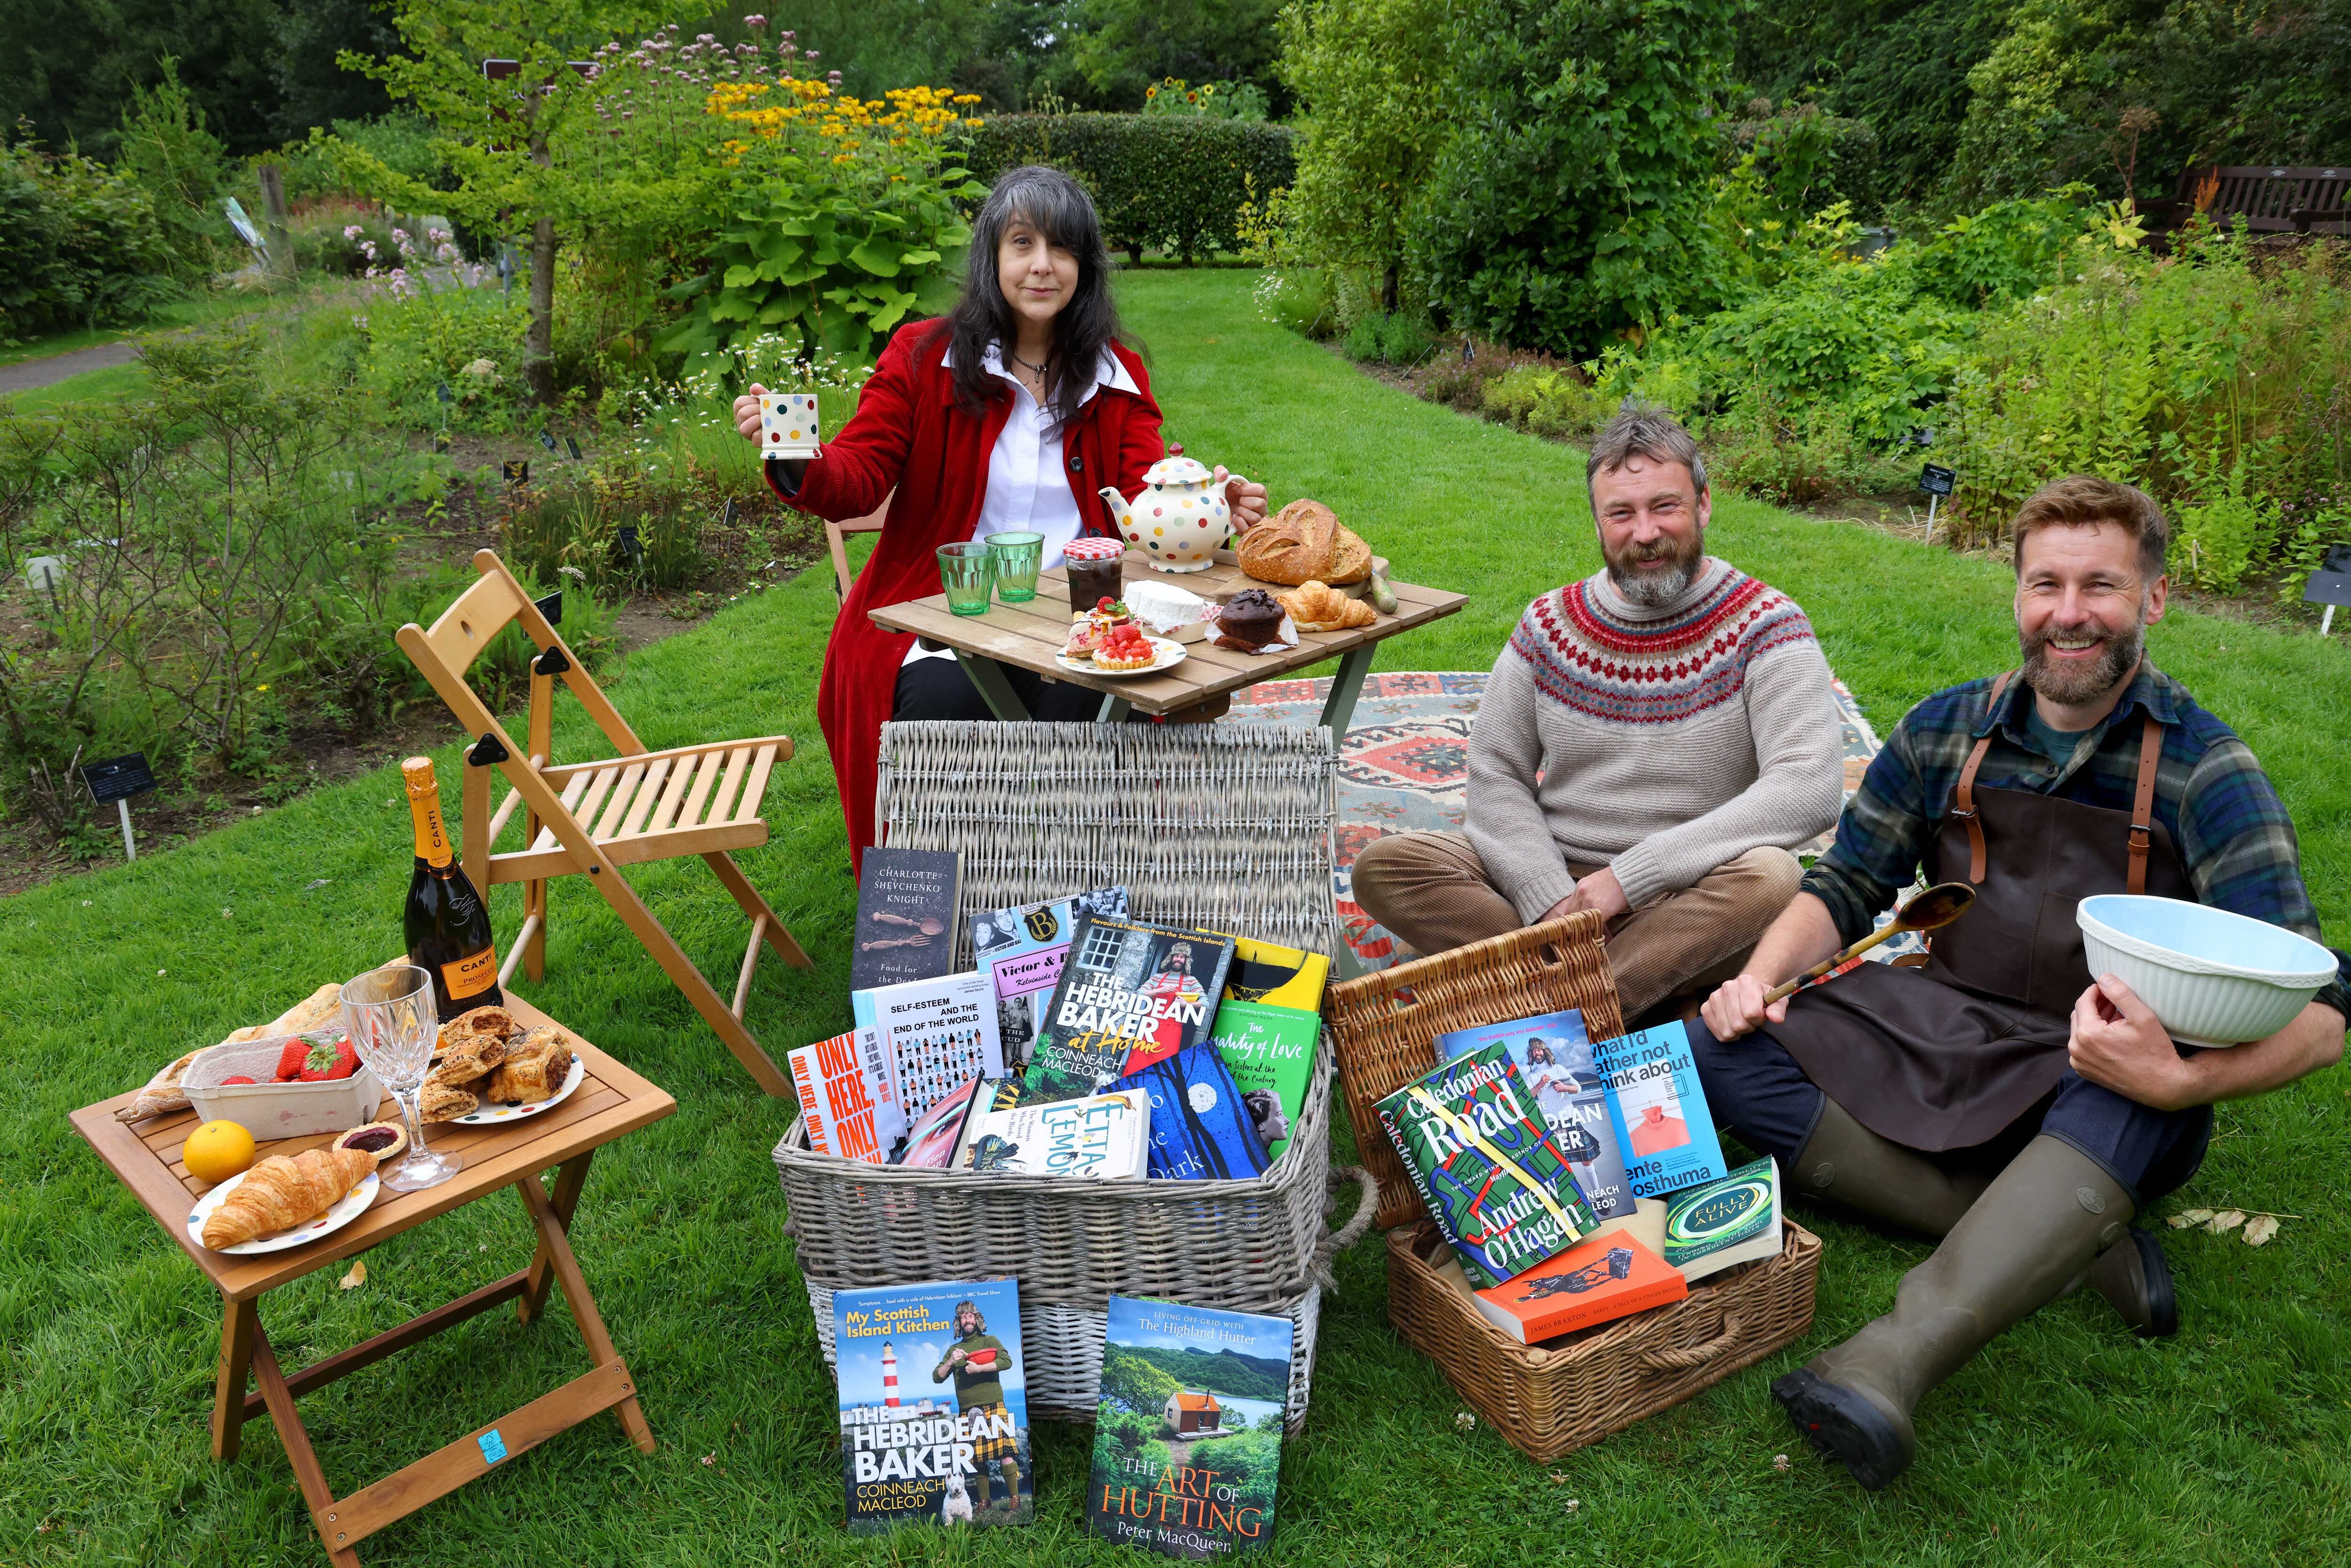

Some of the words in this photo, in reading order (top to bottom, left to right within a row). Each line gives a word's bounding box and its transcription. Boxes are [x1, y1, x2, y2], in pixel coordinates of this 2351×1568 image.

[428, 811, 441, 848] CANTI
[875, 882, 940, 892] SHEVCHENKO
[879, 869, 938, 880] CHARLOTTE
[887, 895, 925, 904] KNIGHT
[1091, 918, 1117, 928] Flavours
[1124, 924, 1149, 933] Folklore
[1178, 933, 1202, 942] Scottish
[1203, 937, 1226, 946] Islands
[461, 953, 491, 972] CANTI
[464, 965, 494, 984] PROSECCO
[1002, 962, 1040, 977] Victor
[1044, 956, 1056, 967] &
[1016, 973, 1052, 986] Kelvinside
[1093, 972, 1125, 990] THE
[891, 998, 950, 1013] SELF-ESTEEM
[941, 1007, 959, 1016] AND
[961, 1003, 978, 1012] THE
[1065, 982, 1207, 1026] HEBRIDEAN
[894, 1025, 912, 1034] END
[914, 1022, 926, 1031] OF
[928, 1019, 945, 1028] THE
[947, 1014, 979, 1025] WORLD
[1056, 1001, 1160, 1043] BAKER
[1247, 1022, 1265, 1034] The
[1068, 1028, 1096, 1053] at
[1096, 1024, 1166, 1056] Home
[1256, 1040, 1268, 1059] of
[1270, 1032, 1304, 1059] Love
[1488, 1031, 1516, 1040] Scottish-sexy,
[1627, 1030, 1648, 1048] I'd
[815, 1032, 859, 1079] ONLY
[1046, 1046, 1123, 1071] COINNEACH
[1641, 1041, 1672, 1062] not
[791, 1055, 811, 1081] ONLY
[875, 1062, 884, 1072] GREAT
[1041, 1056, 1102, 1078] MACLEOD
[1234, 1060, 1254, 1071] Sisters
[1254, 1062, 1263, 1072] at
[1264, 1064, 1276, 1073] the
[1639, 1053, 1691, 1081] about
[1238, 1072, 1249, 1081] the
[1251, 1074, 1277, 1088] Century
[1407, 1059, 1505, 1119] Caledonian
[798, 1084, 818, 1115] HERE,
[825, 1069, 876, 1122] HERE,
[806, 1114, 826, 1141] ONLY
[1007, 1121, 1016, 1137] Birds
[1016, 1123, 1025, 1139] Saved
[1026, 1120, 1035, 1142] Woman
[1418, 1077, 1527, 1164] Road
[836, 1110, 879, 1159] ONLY
[1081, 1103, 1123, 1167] ETTA
[1378, 1110, 1431, 1196] Caledonian
[1426, 1194, 1459, 1245] Road
[1451, 1183, 1462, 1192] THE
[1512, 1146, 1533, 1160] AUTHOR
[1677, 1179, 1723, 1197] ELIZABETH
[1477, 1177, 1561, 1240] Andrew
[1695, 1201, 1747, 1227] ALIVE
[1696, 1192, 1749, 1218] FULLY
[1484, 1203, 1584, 1269] O'Hagan
[1678, 1244, 1711, 1260] TENDING
[1744, 1221, 1763, 1230] SOUL
[1693, 1237, 1734, 1256] TURBULENT
[1738, 1225, 1760, 1237] TIMES
[846, 1311, 869, 1326] My
[874, 1305, 929, 1322] Scottish
[1154, 1311, 1181, 1322] LIVING
[1183, 1314, 1220, 1326] OFF-GRID
[1223, 1320, 1244, 1330] WITH
[1531, 1323, 1552, 1335] JAMES
[1554, 1312, 1586, 1327] BRAXTON
[1642, 1291, 1662, 1301] STOLEN
[1663, 1285, 1682, 1294] BRONZE
[846, 1322, 891, 1338] Island
[896, 1318, 950, 1334] Kitchen
[1139, 1318, 1160, 1332] The
[1164, 1322, 1214, 1340] Highland
[1219, 1330, 1256, 1346] Hutter
[852, 1405, 890, 1425] THE
[853, 1413, 1016, 1451] HEBRIDEAN
[854, 1442, 978, 1483] BAKER
[857, 1479, 945, 1498] COINNEACH
[1123, 1457, 1157, 1477] THE
[1156, 1463, 1220, 1499] ART
[1216, 1486, 1240, 1503] OF
[858, 1495, 926, 1513] MACLEOD
[1101, 1484, 1262, 1538] HUTTING
[1118, 1522, 1152, 1540] Peter
[1158, 1529, 1231, 1552] MacQueen
